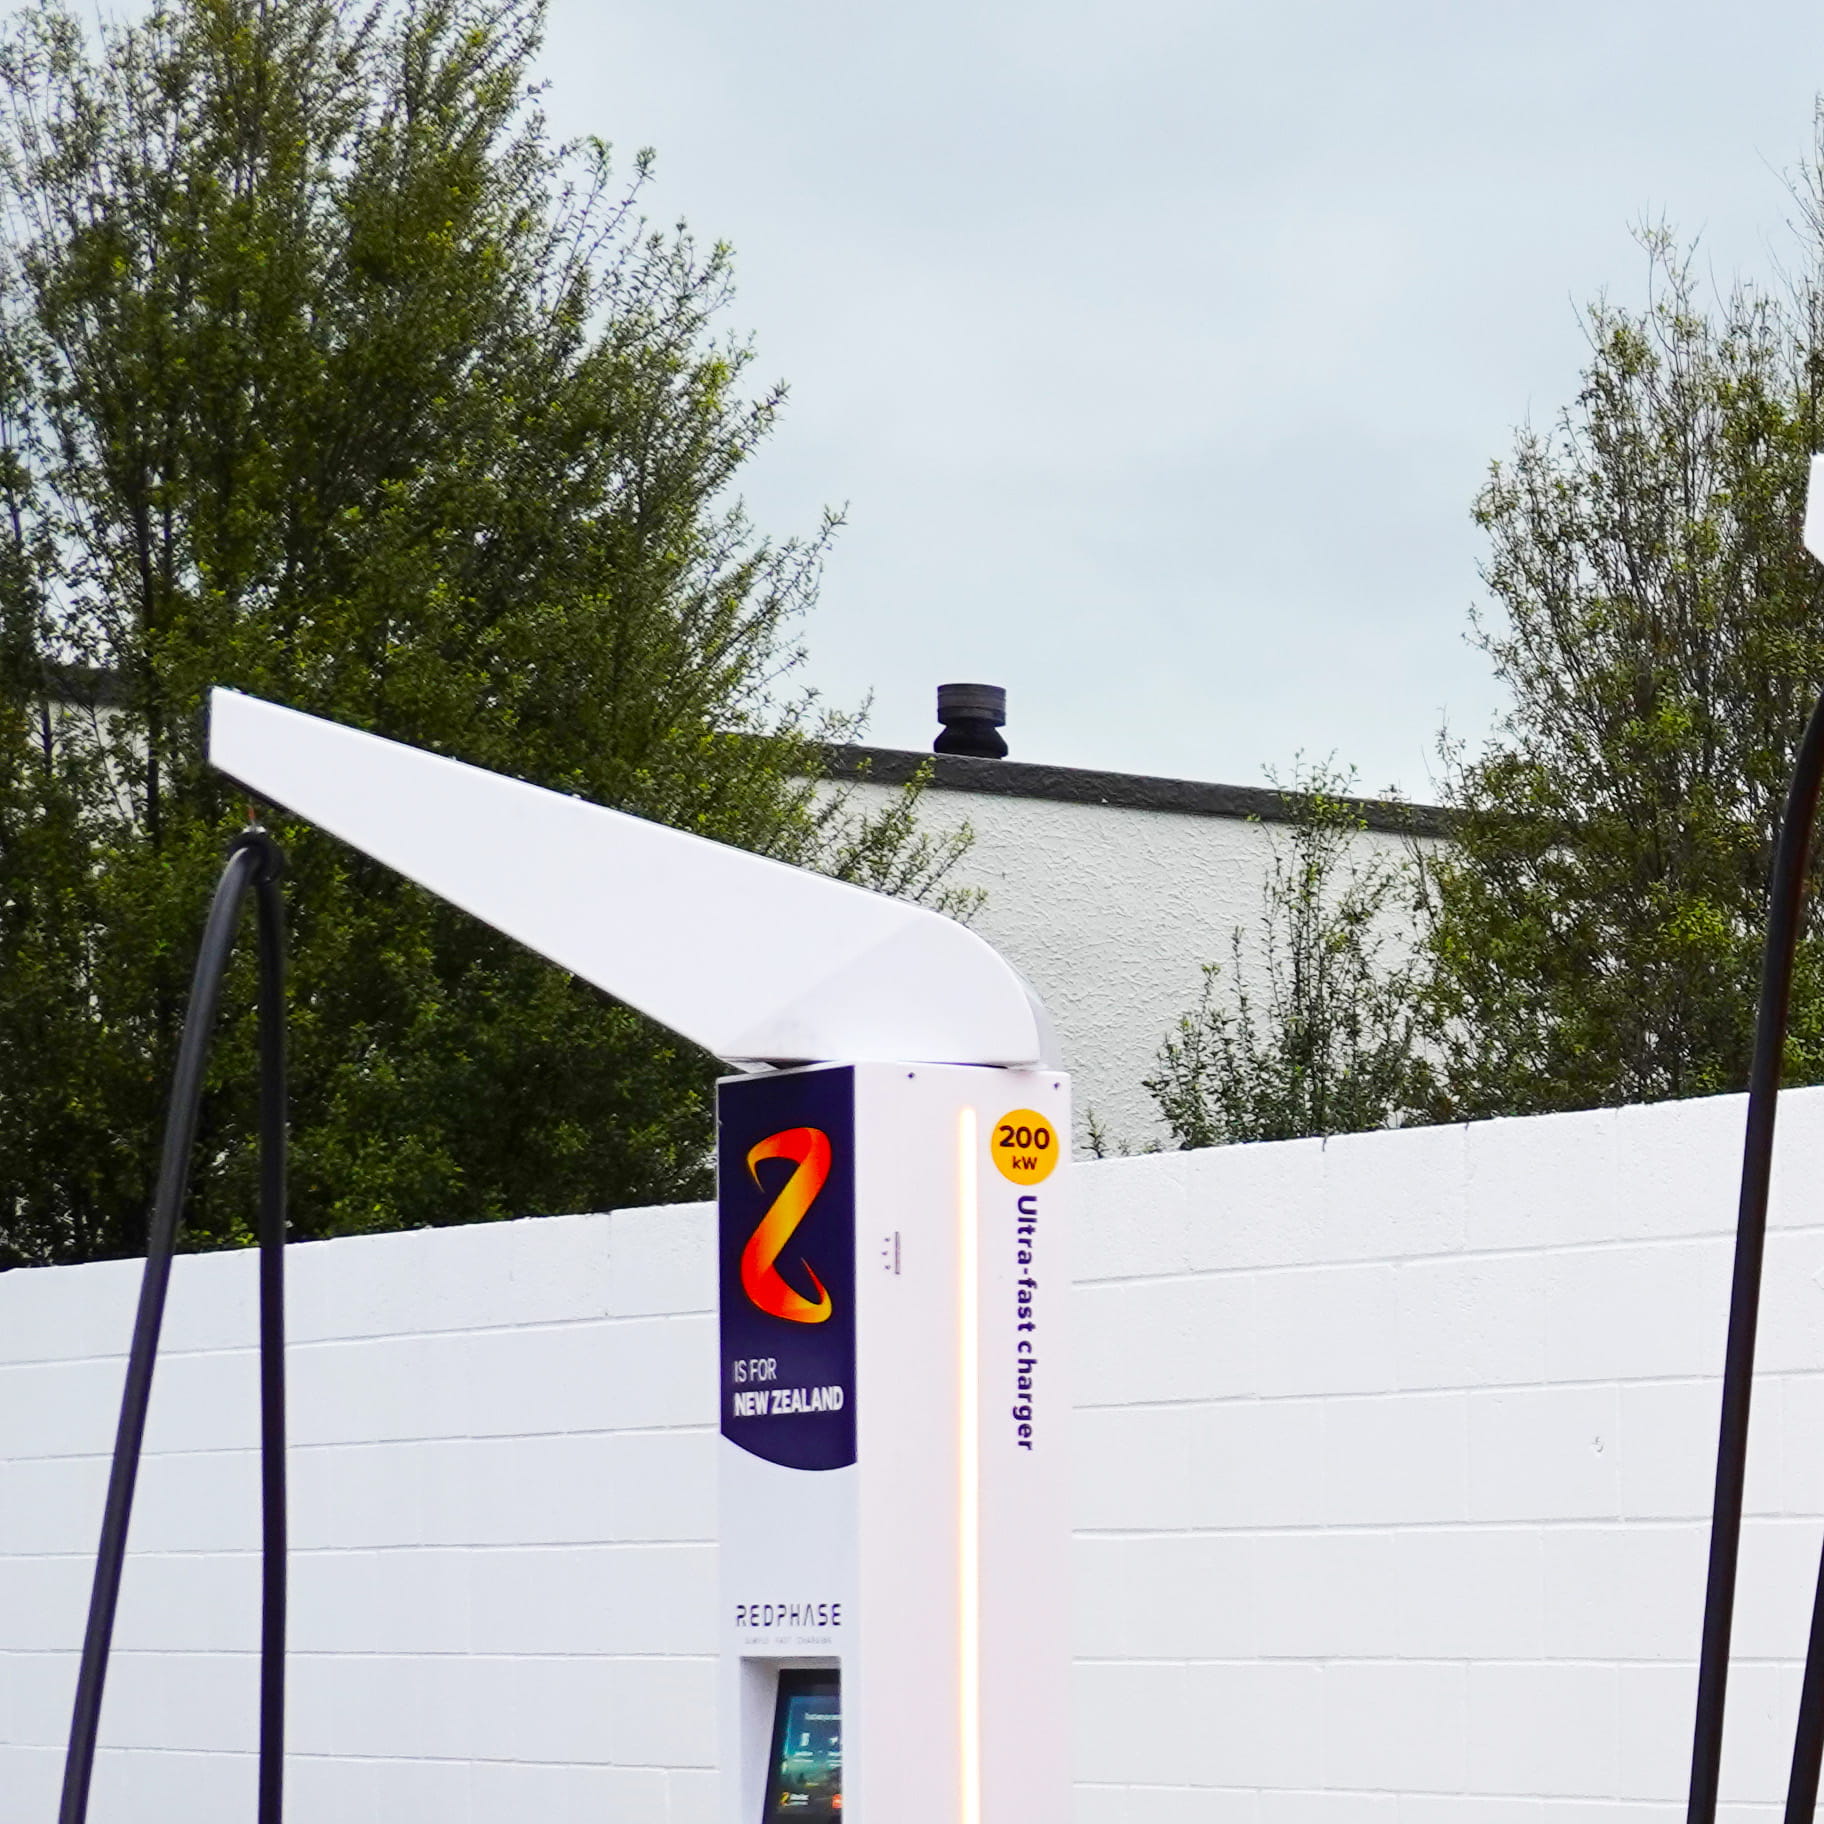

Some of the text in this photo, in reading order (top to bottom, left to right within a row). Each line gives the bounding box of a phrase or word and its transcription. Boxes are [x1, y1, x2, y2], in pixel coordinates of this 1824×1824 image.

[999, 1125, 1050, 1150] 200
[1012, 1156, 1037, 1170] kW
[740, 1127, 832, 1323] Z
[1012, 1195, 1038, 1451] Ultra-fast charger
[734, 1358, 777, 1382] IS FOR
[734, 1386, 844, 1417] NEW ZEALAND
[736, 1603, 841, 1627] REDPHASE
